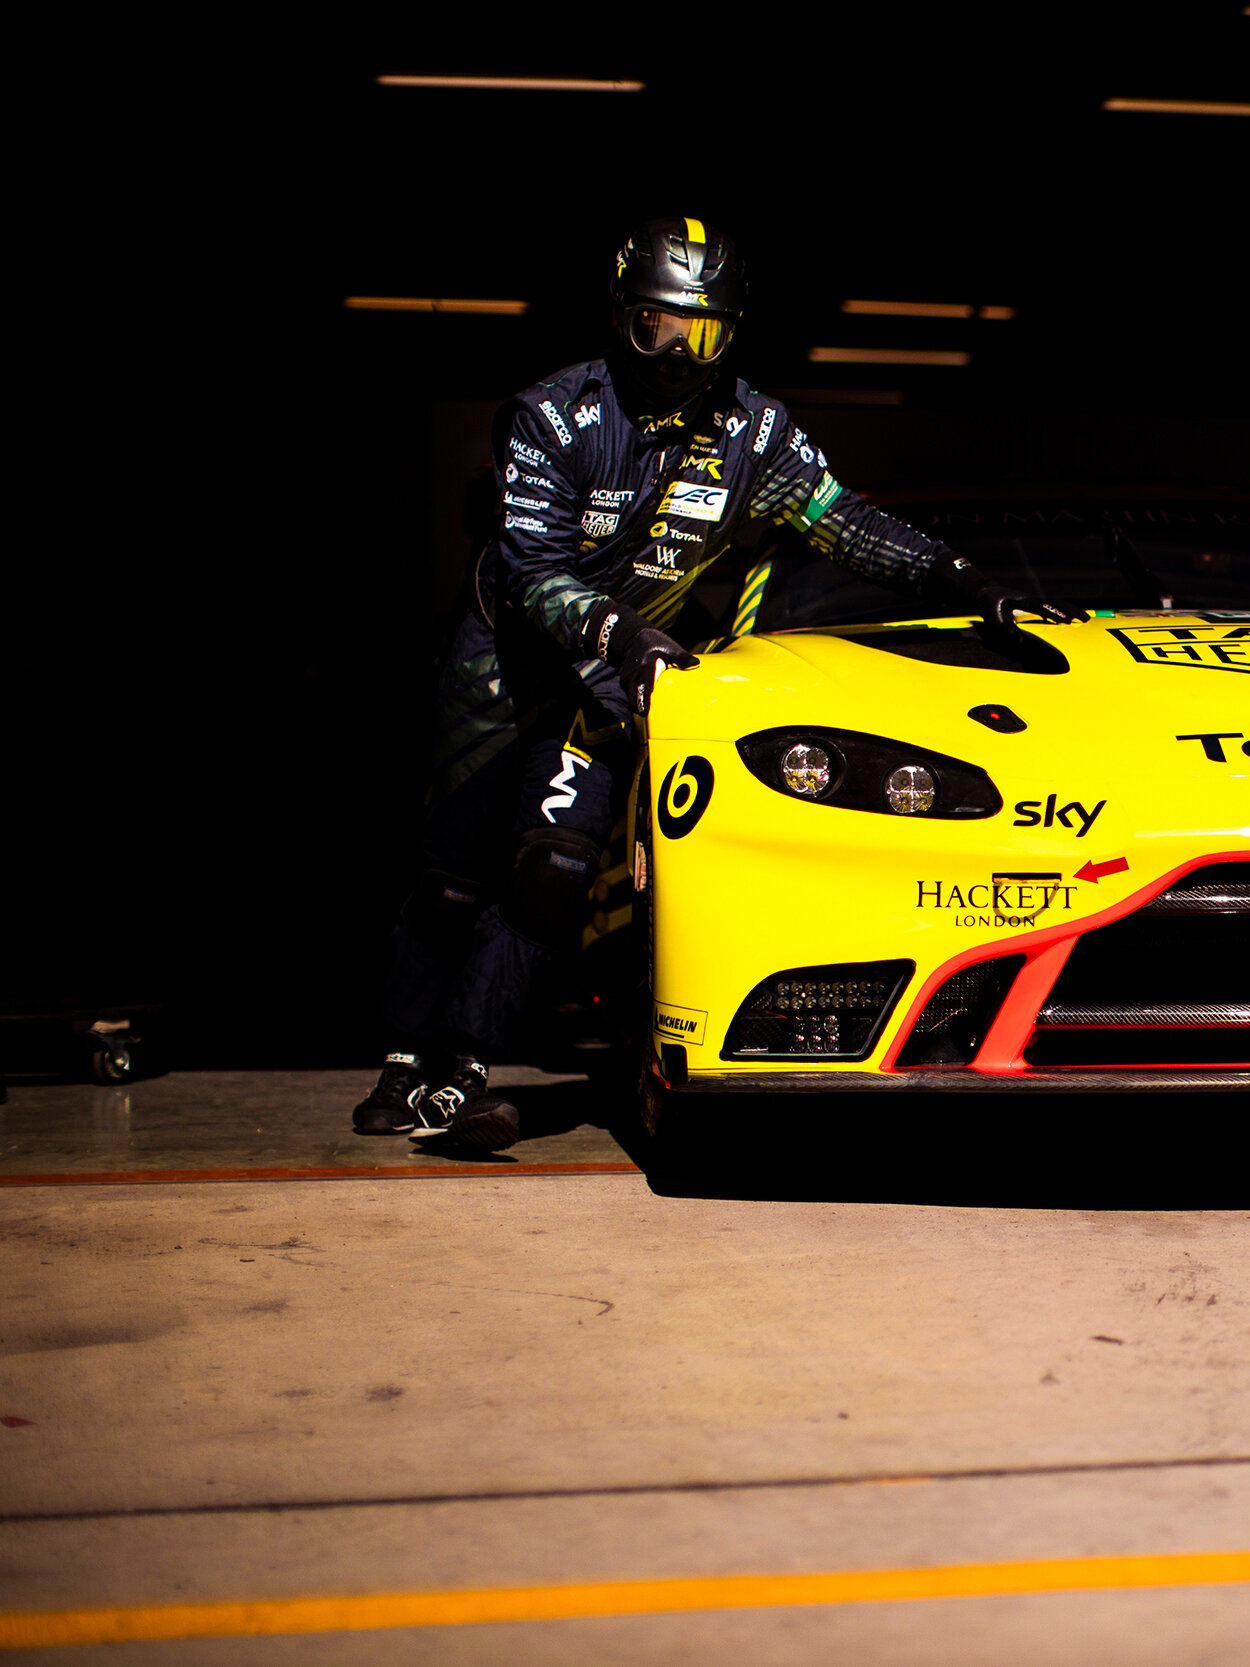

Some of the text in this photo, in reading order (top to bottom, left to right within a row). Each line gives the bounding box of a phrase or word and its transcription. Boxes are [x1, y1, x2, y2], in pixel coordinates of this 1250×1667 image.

[541, 400, 573, 445] sparco
[753, 407, 775, 454] sparco
[519, 472, 555, 489] TOTAL
[589, 489, 635, 502] ACKETT
[591, 499, 620, 508] LONDON
[588, 512, 616, 525] TAG
[670, 528, 703, 543] TOTAL
[1013, 793, 1108, 838] sky
[916, 880, 1078, 909] HACKETT
[955, 914, 1036, 928] LONDON
[659, 1012, 698, 1033] MICHELIN
